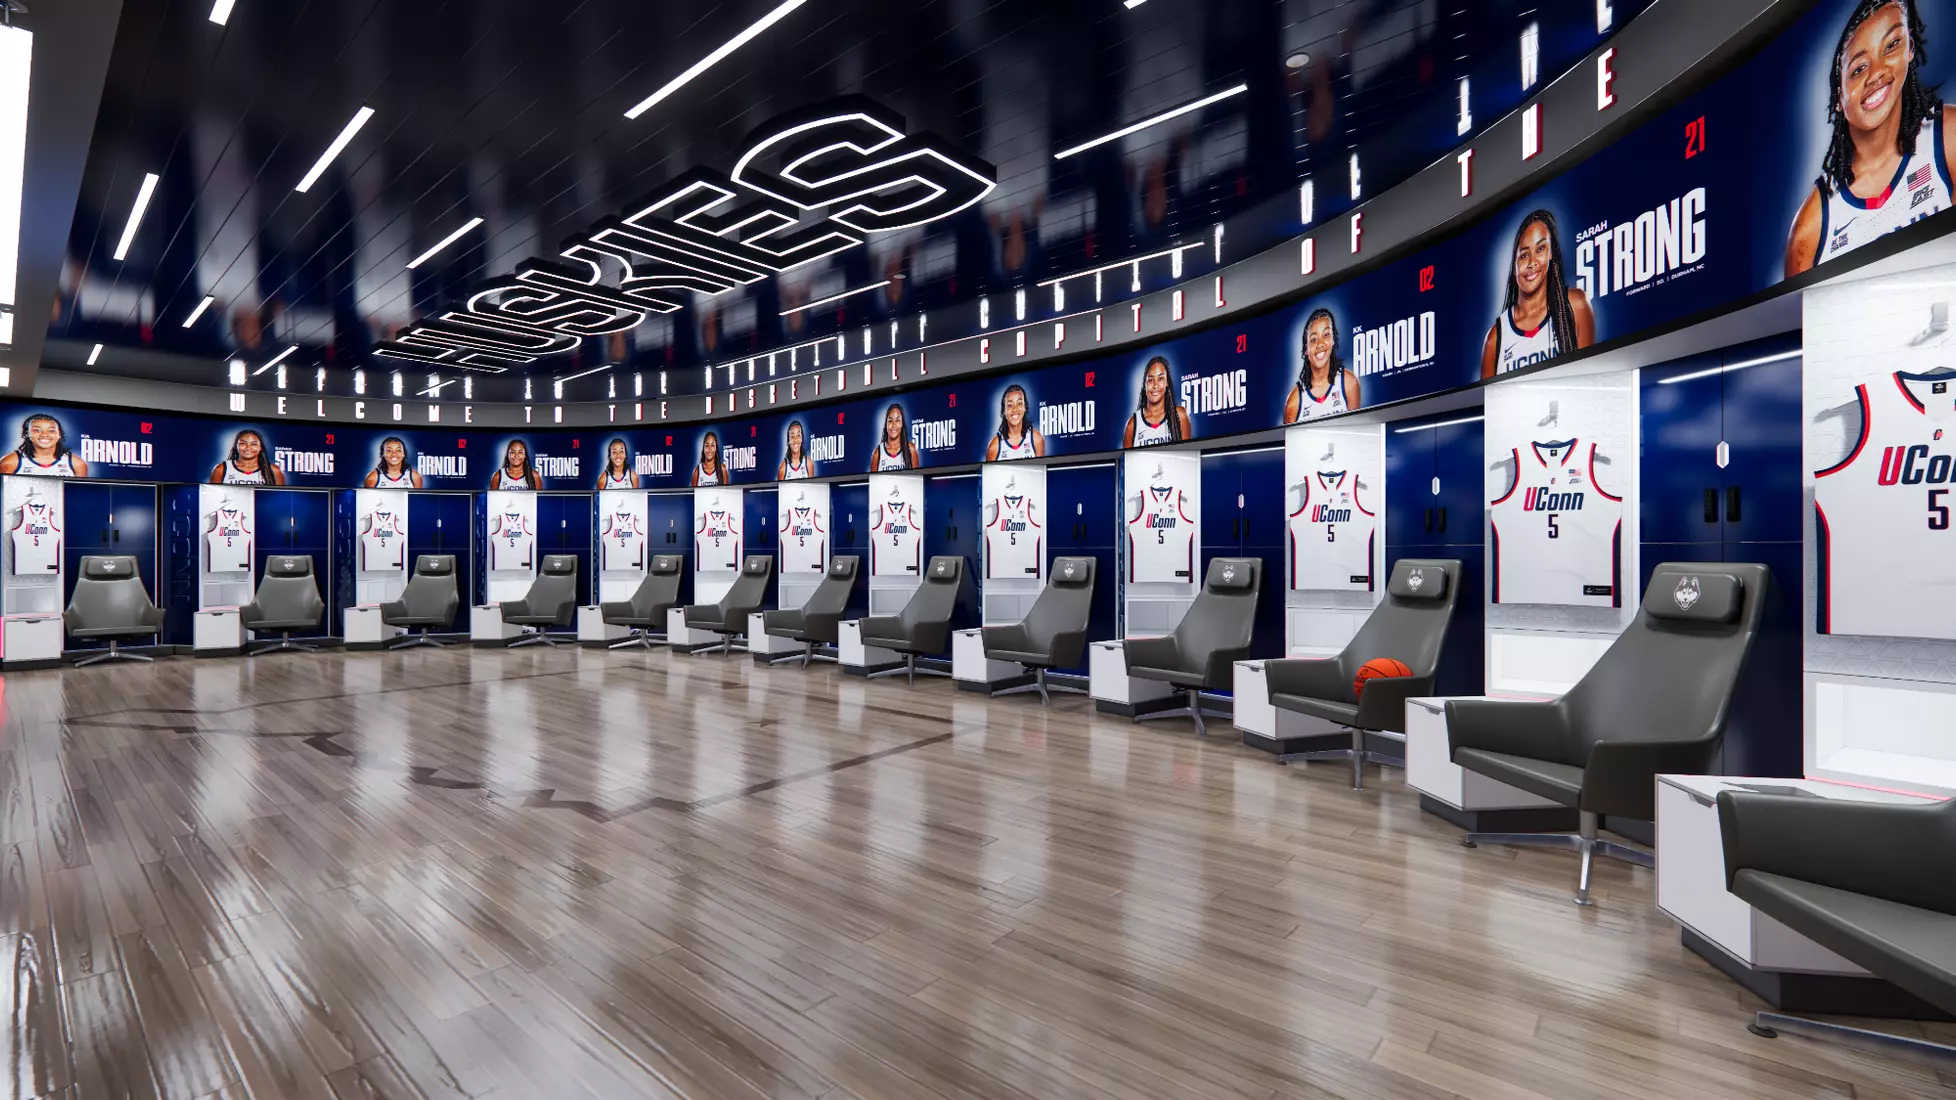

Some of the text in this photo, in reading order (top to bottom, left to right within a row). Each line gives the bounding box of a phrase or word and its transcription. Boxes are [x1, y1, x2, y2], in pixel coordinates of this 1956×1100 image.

[1685, 115, 1705, 160] 21
[230, 48, 1617, 424] WELCOME TO THE BASKETBALL CAPITAL OF THE
[1576, 220, 1608, 242] SARAH
[371, 110, 997, 374] HUSKIES
[1576, 187, 1706, 301] STRONG
[1420, 265, 1434, 292] 02
[1236, 334, 1247, 354] 21
[1353, 311, 1435, 377] ARNOLD
[1085, 372, 1095, 388] 02
[1181, 372, 1198, 381] SARAH
[1181, 369, 1247, 416] STRONG
[949, 394, 956, 408] 21
[838, 412, 844, 425] 02
[1039, 401, 1095, 436] ARNOLD
[141, 422, 152, 434] 02
[912, 419, 956, 450] STRONG
[326, 434, 334, 444] 21
[458, 439, 467, 448] 02
[573, 440, 580, 448] 21
[666, 436, 673, 446] 02
[81, 438, 152, 465] ARNOLD
[810, 435, 844, 461] ARNOLD
[275, 451, 334, 473] STRONG
[635, 454, 673, 475] ARNOLD
[723, 447, 756, 470] STRONG
[1878, 445, 1956, 486] UCo
[418, 456, 467, 476] ARNOLD
[535, 457, 580, 477] STRONG
[1524, 486, 1584, 511] UConn
[1312, 504, 1351, 522] UConn
[1928, 489, 1949, 530] 5
[1000, 519, 1026, 532] UConn
[1146, 513, 1176, 529] UConn
[1548, 514, 1558, 538] 5
[25, 524, 48, 535] UConn
[219, 526, 240, 536] UConn
[373, 528, 393, 538] UConn
[503, 529, 522, 538] UConn
[613, 528, 632, 538] UConn
[707, 528, 727, 537] UConn
[792, 526, 812, 536] UConn
[884, 523, 907, 534] UConn
[1328, 524, 1334, 542] 5
[34, 536, 39, 546] 5
[228, 537, 231, 547] 5
[381, 538, 385, 547] 5
[510, 538, 514, 547] 5
[621, 538, 625, 547] 5
[715, 538, 719, 547] 5
[800, 537, 804, 547] 5
[894, 535, 898, 546] 5
[1010, 533, 1015, 545] 5
[1158, 530, 1164, 544] 5
